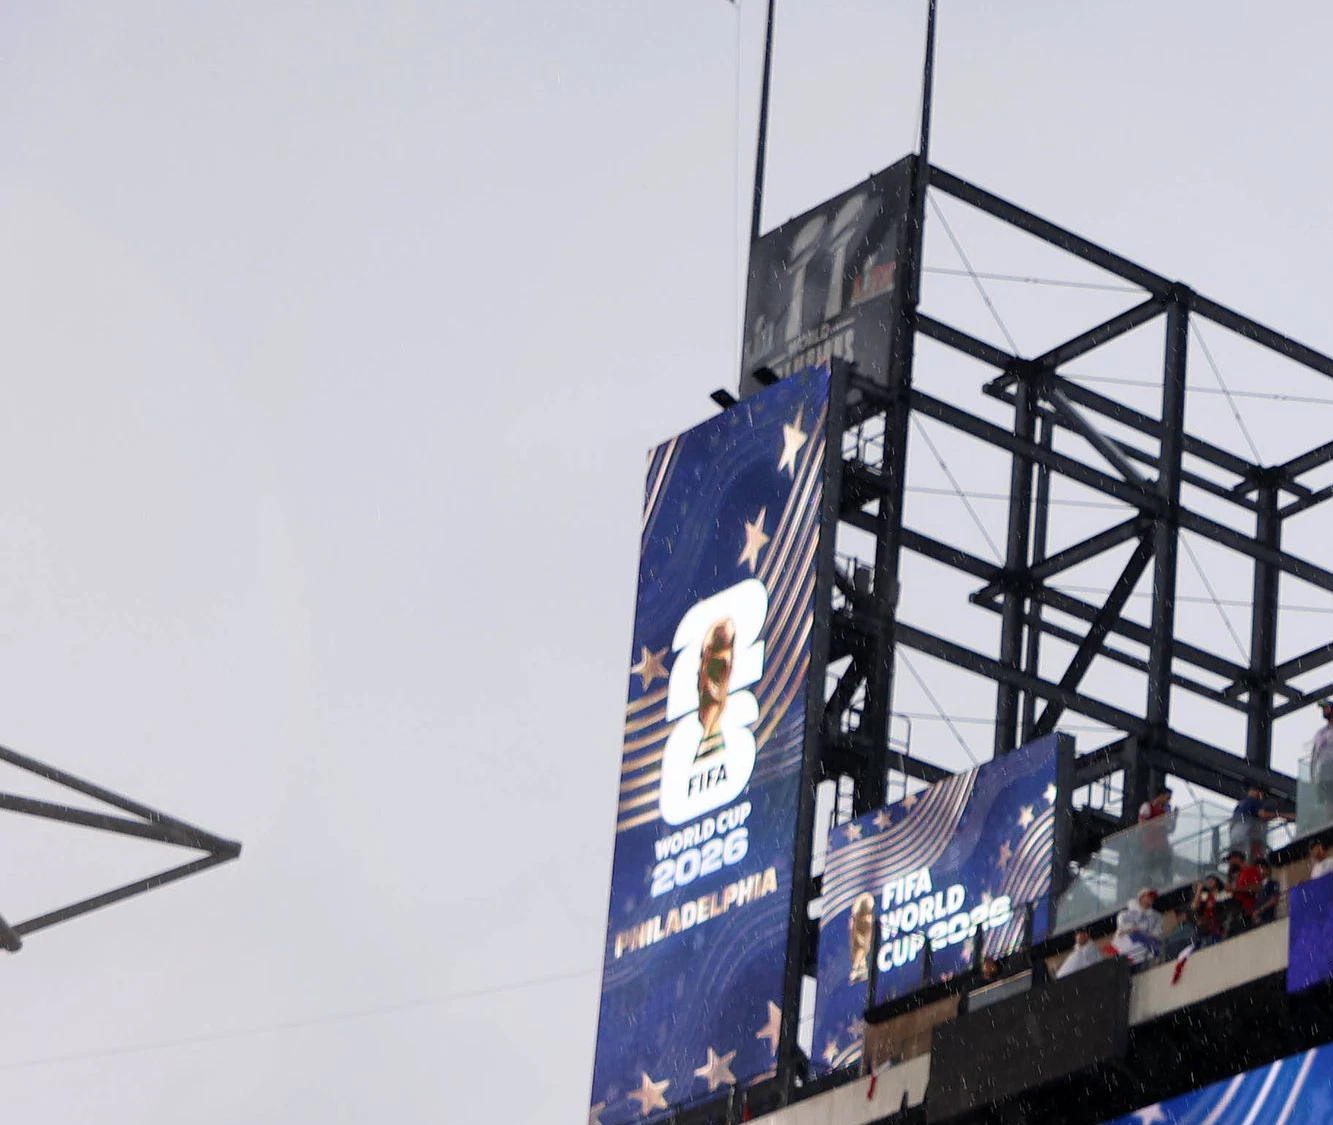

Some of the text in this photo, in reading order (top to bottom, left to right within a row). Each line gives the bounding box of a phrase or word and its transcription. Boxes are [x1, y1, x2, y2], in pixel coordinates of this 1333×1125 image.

[687, 762, 728, 798] FIFA
[655, 801, 752, 860] WORLD CUP
[651, 827, 749, 898] 2026
[881, 866, 932, 910] FIFA
[614, 866, 778, 958] PHILADELPHIA
[880, 884, 966, 941] WORLD
[877, 930, 926, 972] CUP
